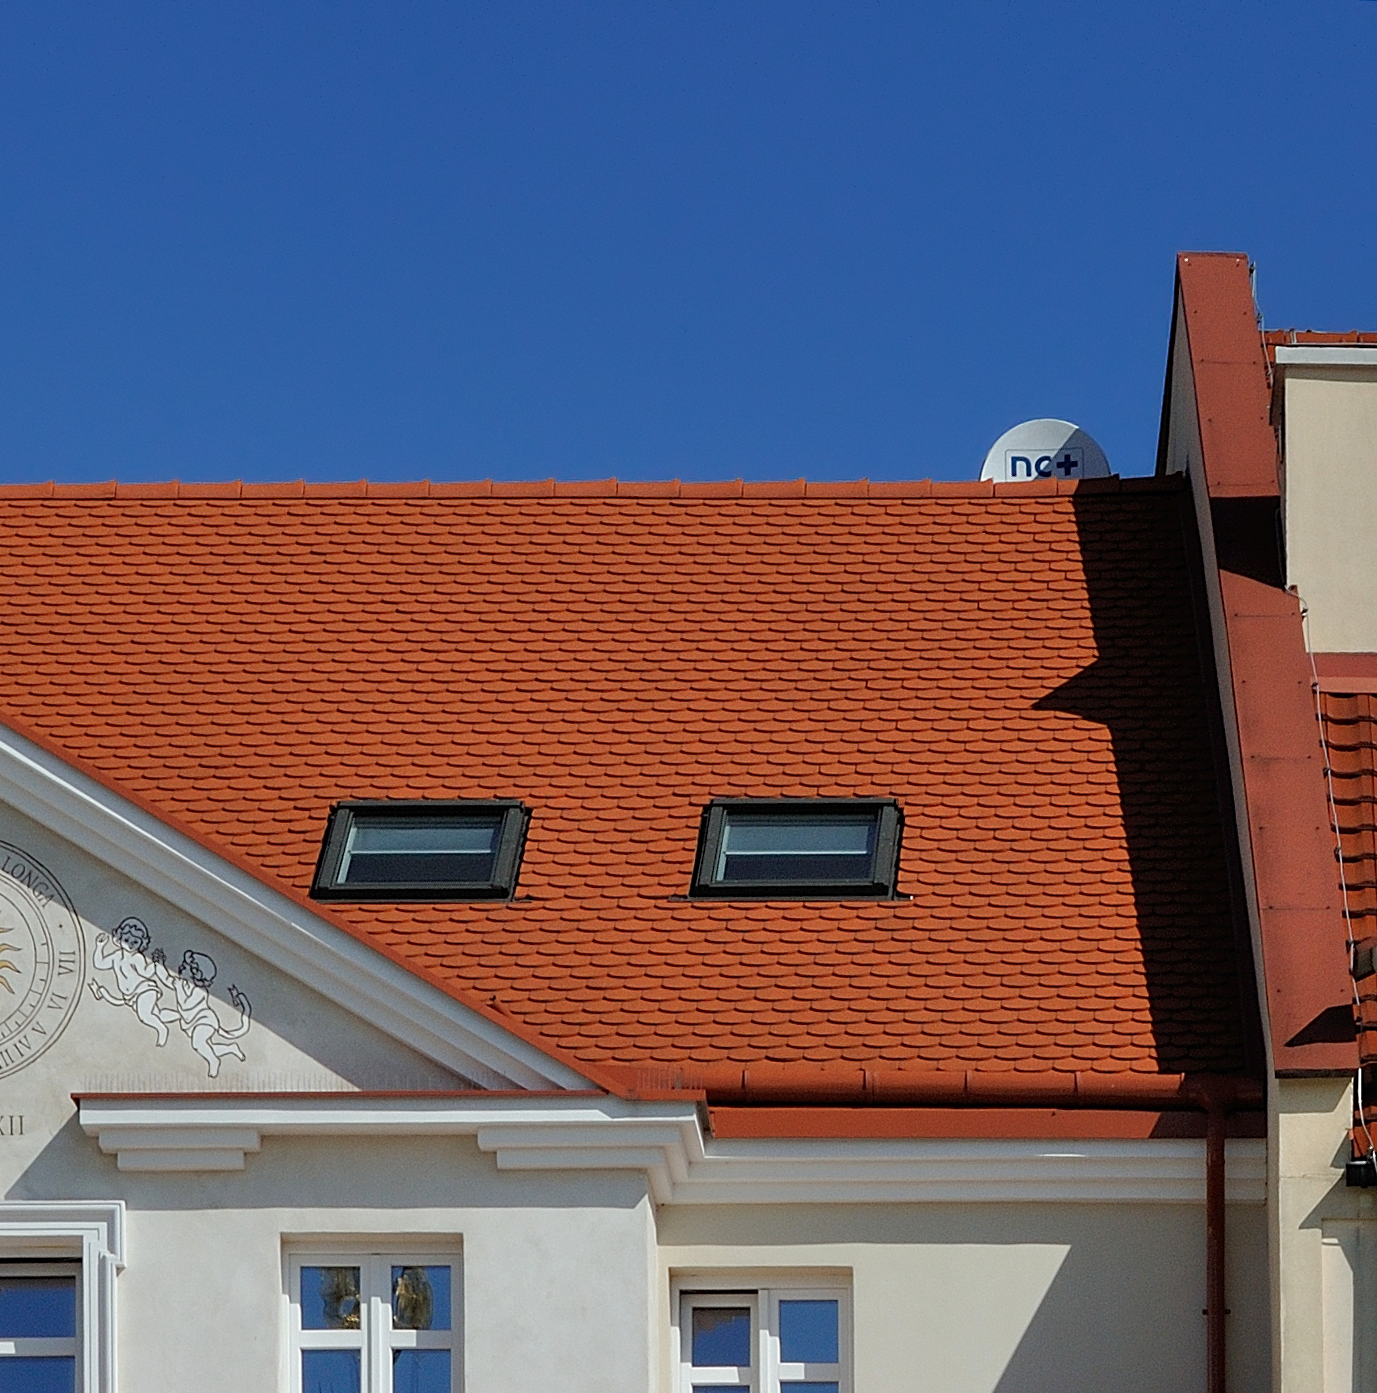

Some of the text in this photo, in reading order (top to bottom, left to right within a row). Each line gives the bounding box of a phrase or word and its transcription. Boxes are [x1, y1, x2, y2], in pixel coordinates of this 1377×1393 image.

[1010, 453, 1079, 478] nc+
[1, 855, 57, 908] LONGA
[31, 1021, 48, 1037] V
[47, 991, 69, 1012] VI
[58, 950, 77, 978] VII
